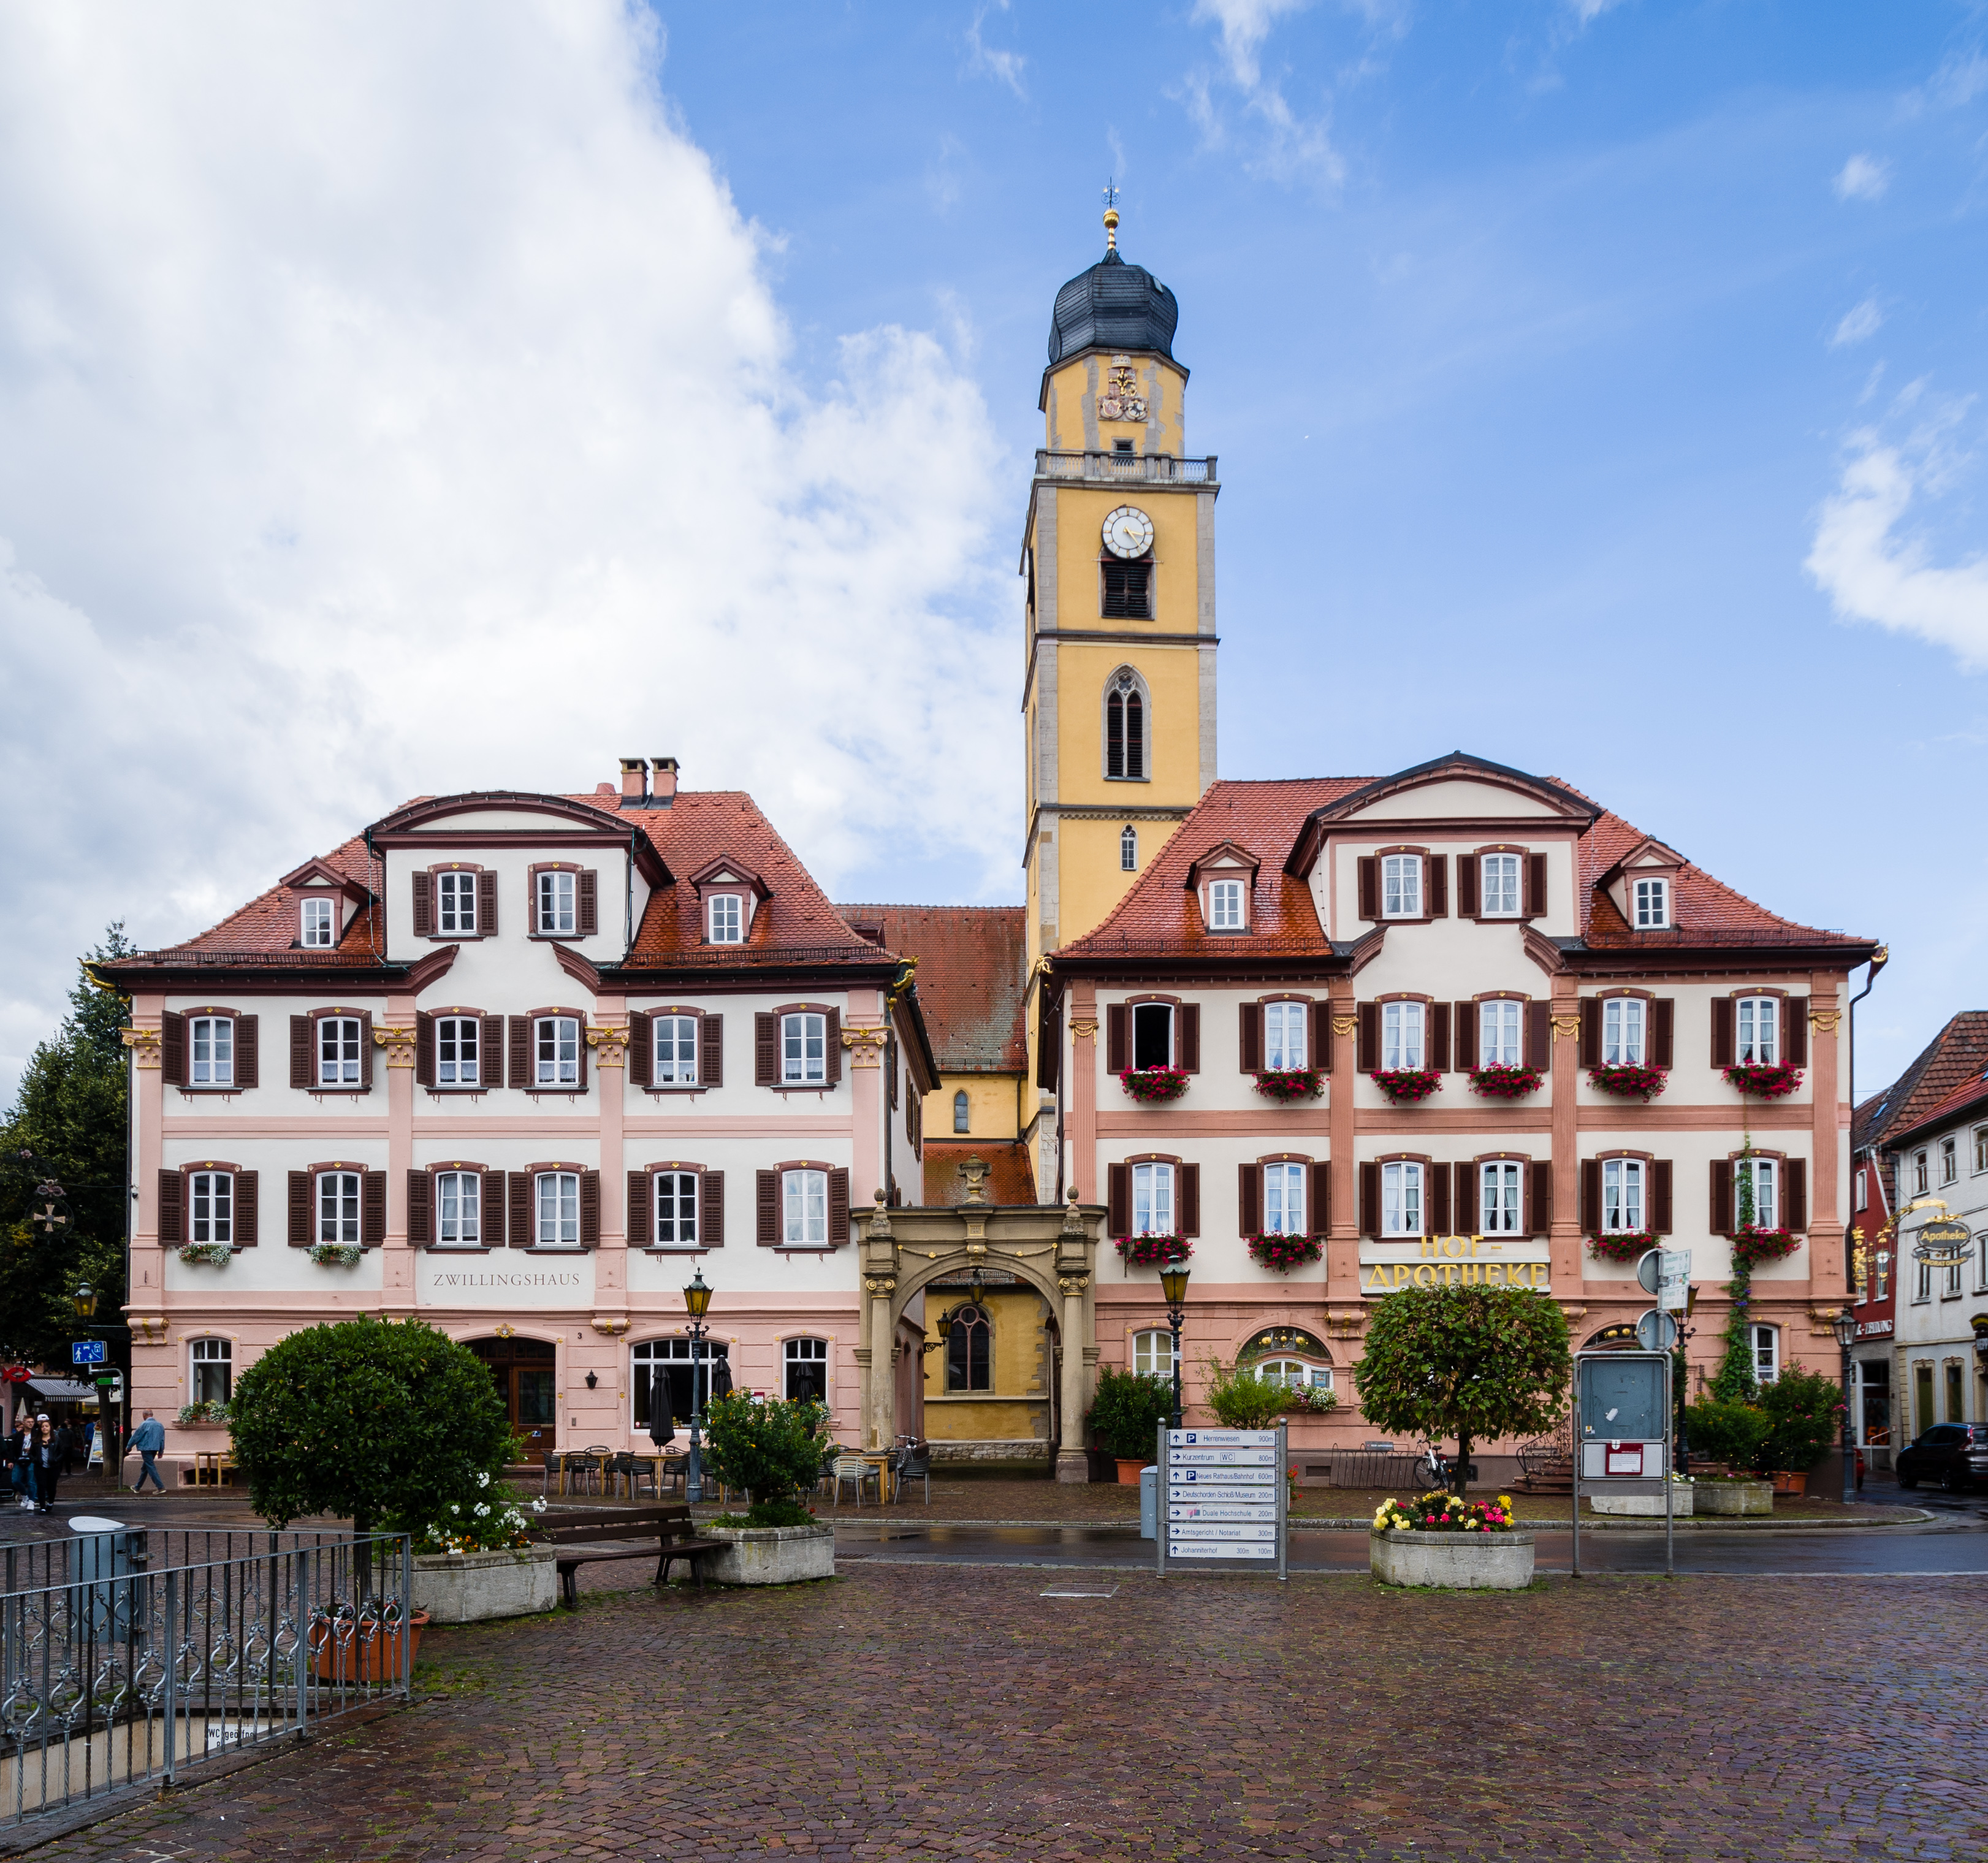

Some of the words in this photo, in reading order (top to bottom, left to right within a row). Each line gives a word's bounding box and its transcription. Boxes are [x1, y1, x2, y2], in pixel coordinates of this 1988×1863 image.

[1921, 1229, 1967, 1243] Apotheke
[1421, 1235, 1502, 1258] HOF-
[433, 1273, 579, 1286] ZWILLINGSHAUS
[1367, 1263, 1547, 1288] APOTHEKE
[208, 1729, 220, 1738] WC
